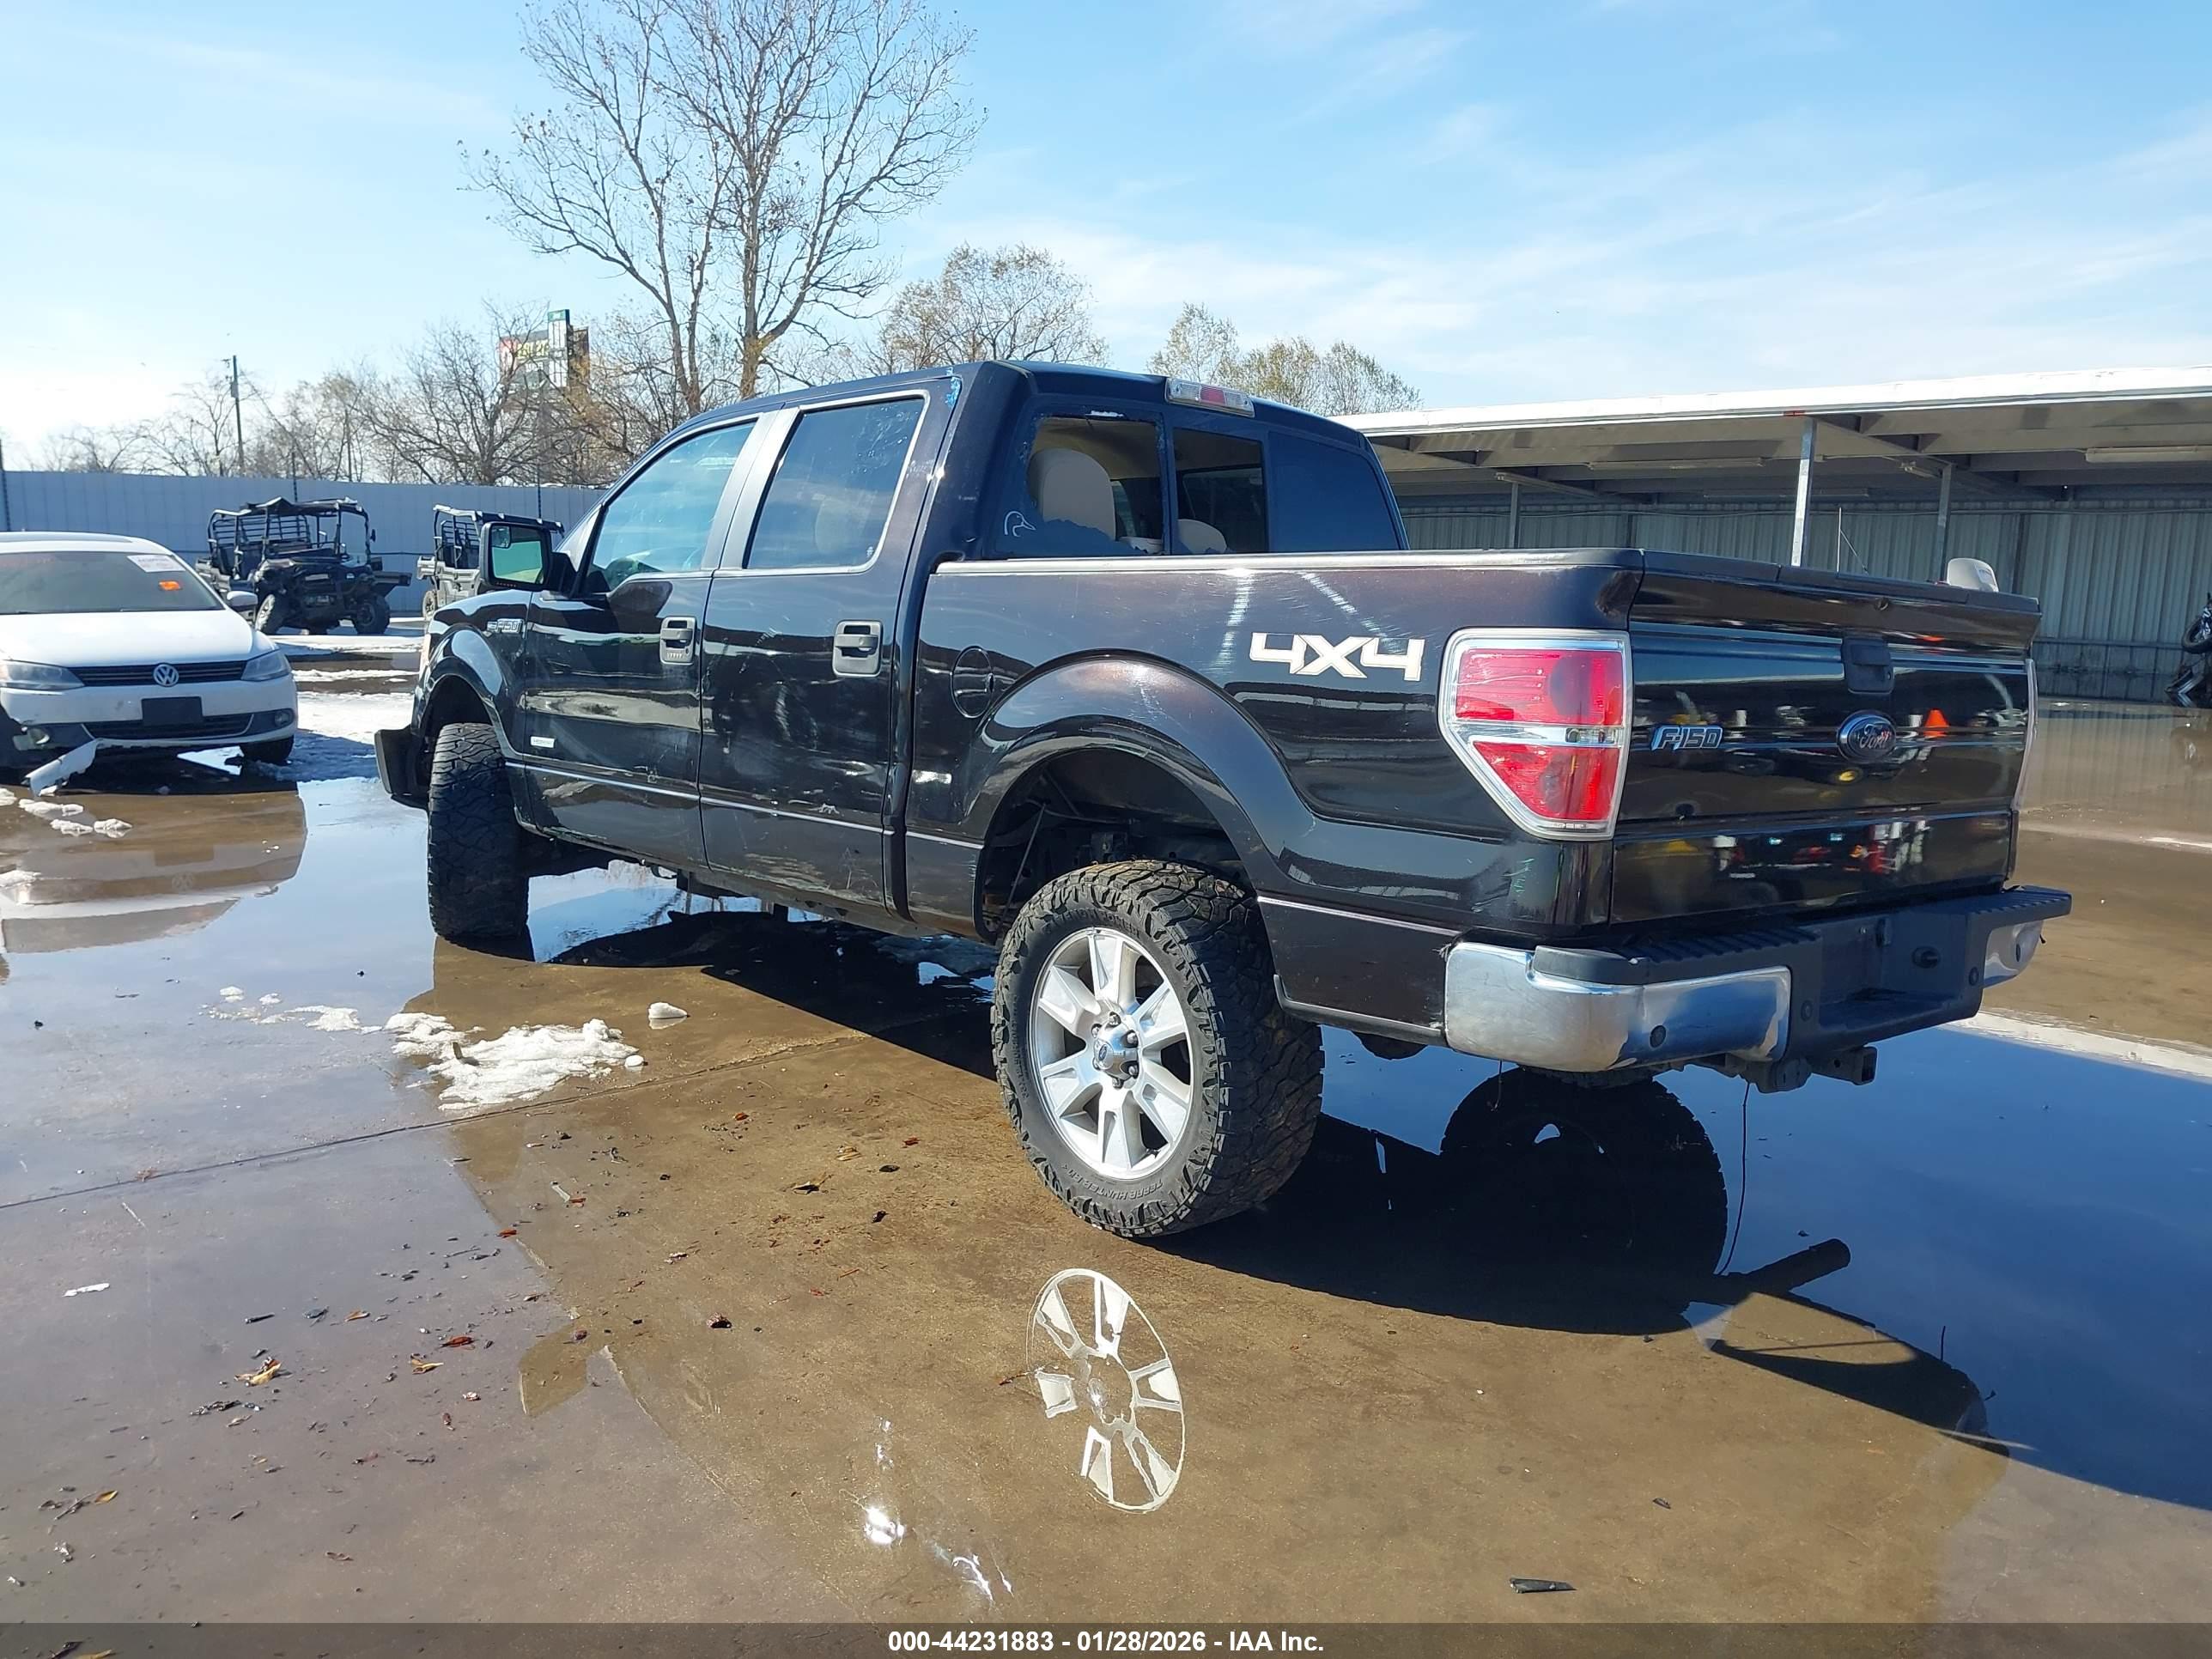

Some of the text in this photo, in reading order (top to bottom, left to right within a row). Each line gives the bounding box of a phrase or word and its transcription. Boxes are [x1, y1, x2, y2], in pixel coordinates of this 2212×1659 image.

[1249, 632, 1425, 682] 4X4
[1651, 726, 1723, 750] F-150
[1859, 723, 1890, 750] Ford
